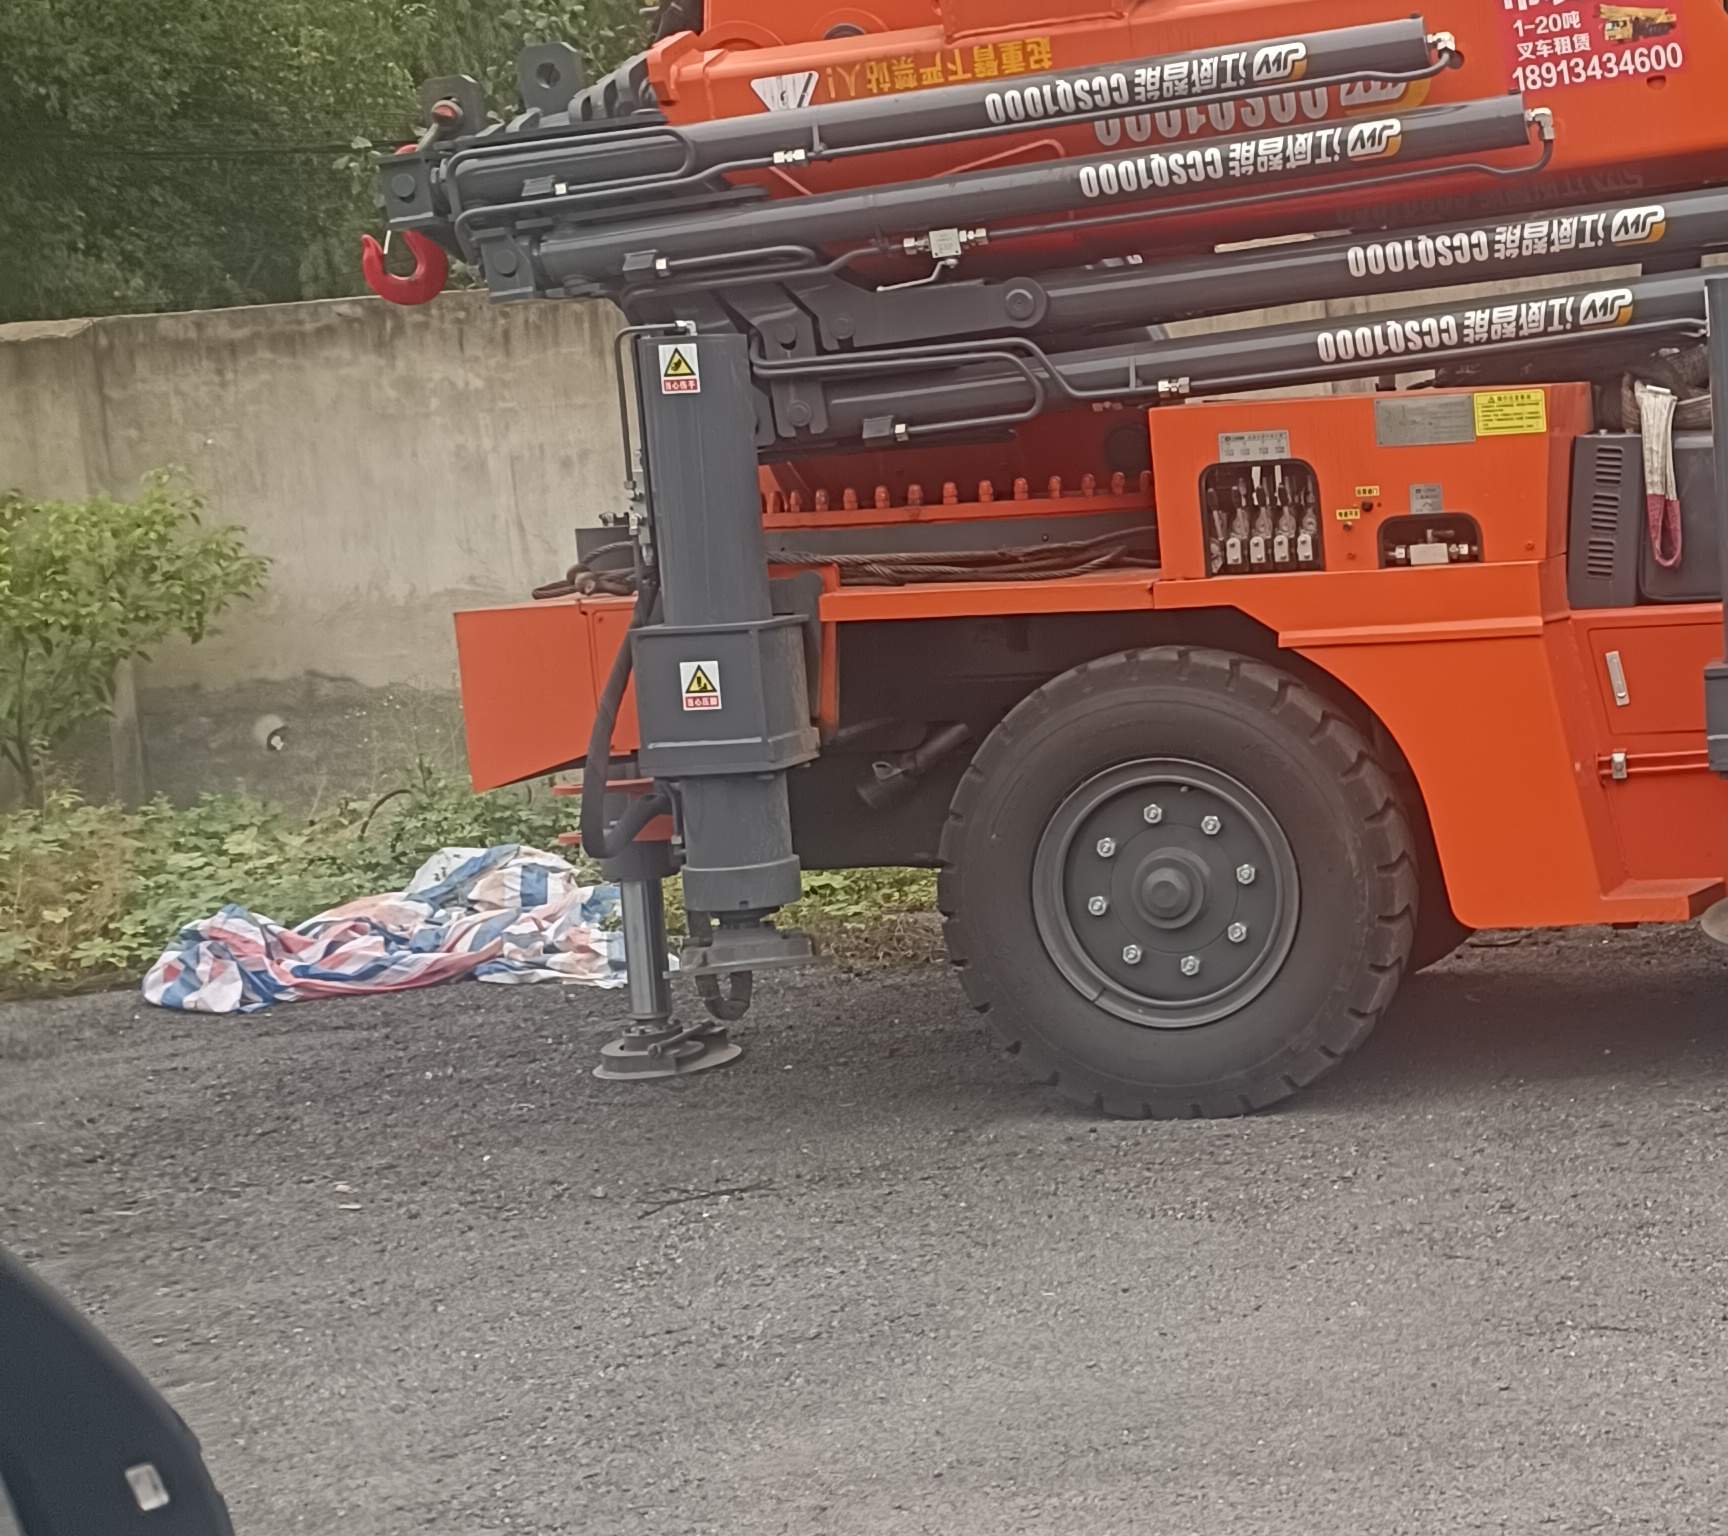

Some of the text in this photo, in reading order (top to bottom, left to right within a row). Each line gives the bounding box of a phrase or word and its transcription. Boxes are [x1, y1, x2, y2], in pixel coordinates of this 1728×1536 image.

[1513, 10, 1582, 37] 1-20吨
[1133, 51, 1247, 101] 江威智能
[1511, 42, 1683, 92] 18913434600
[985, 73, 1127, 124] CCSQ1000
[1079, 146, 1223, 198] CCSQ1000
[1229, 127, 1342, 176] 江威智能
[1347, 230, 1488, 277] CCSQ1000
[1494, 213, 1606, 260] 江威智能
[1316, 315, 1458, 363] CCSQ1000
[1463, 296, 1574, 343] 江威智能
